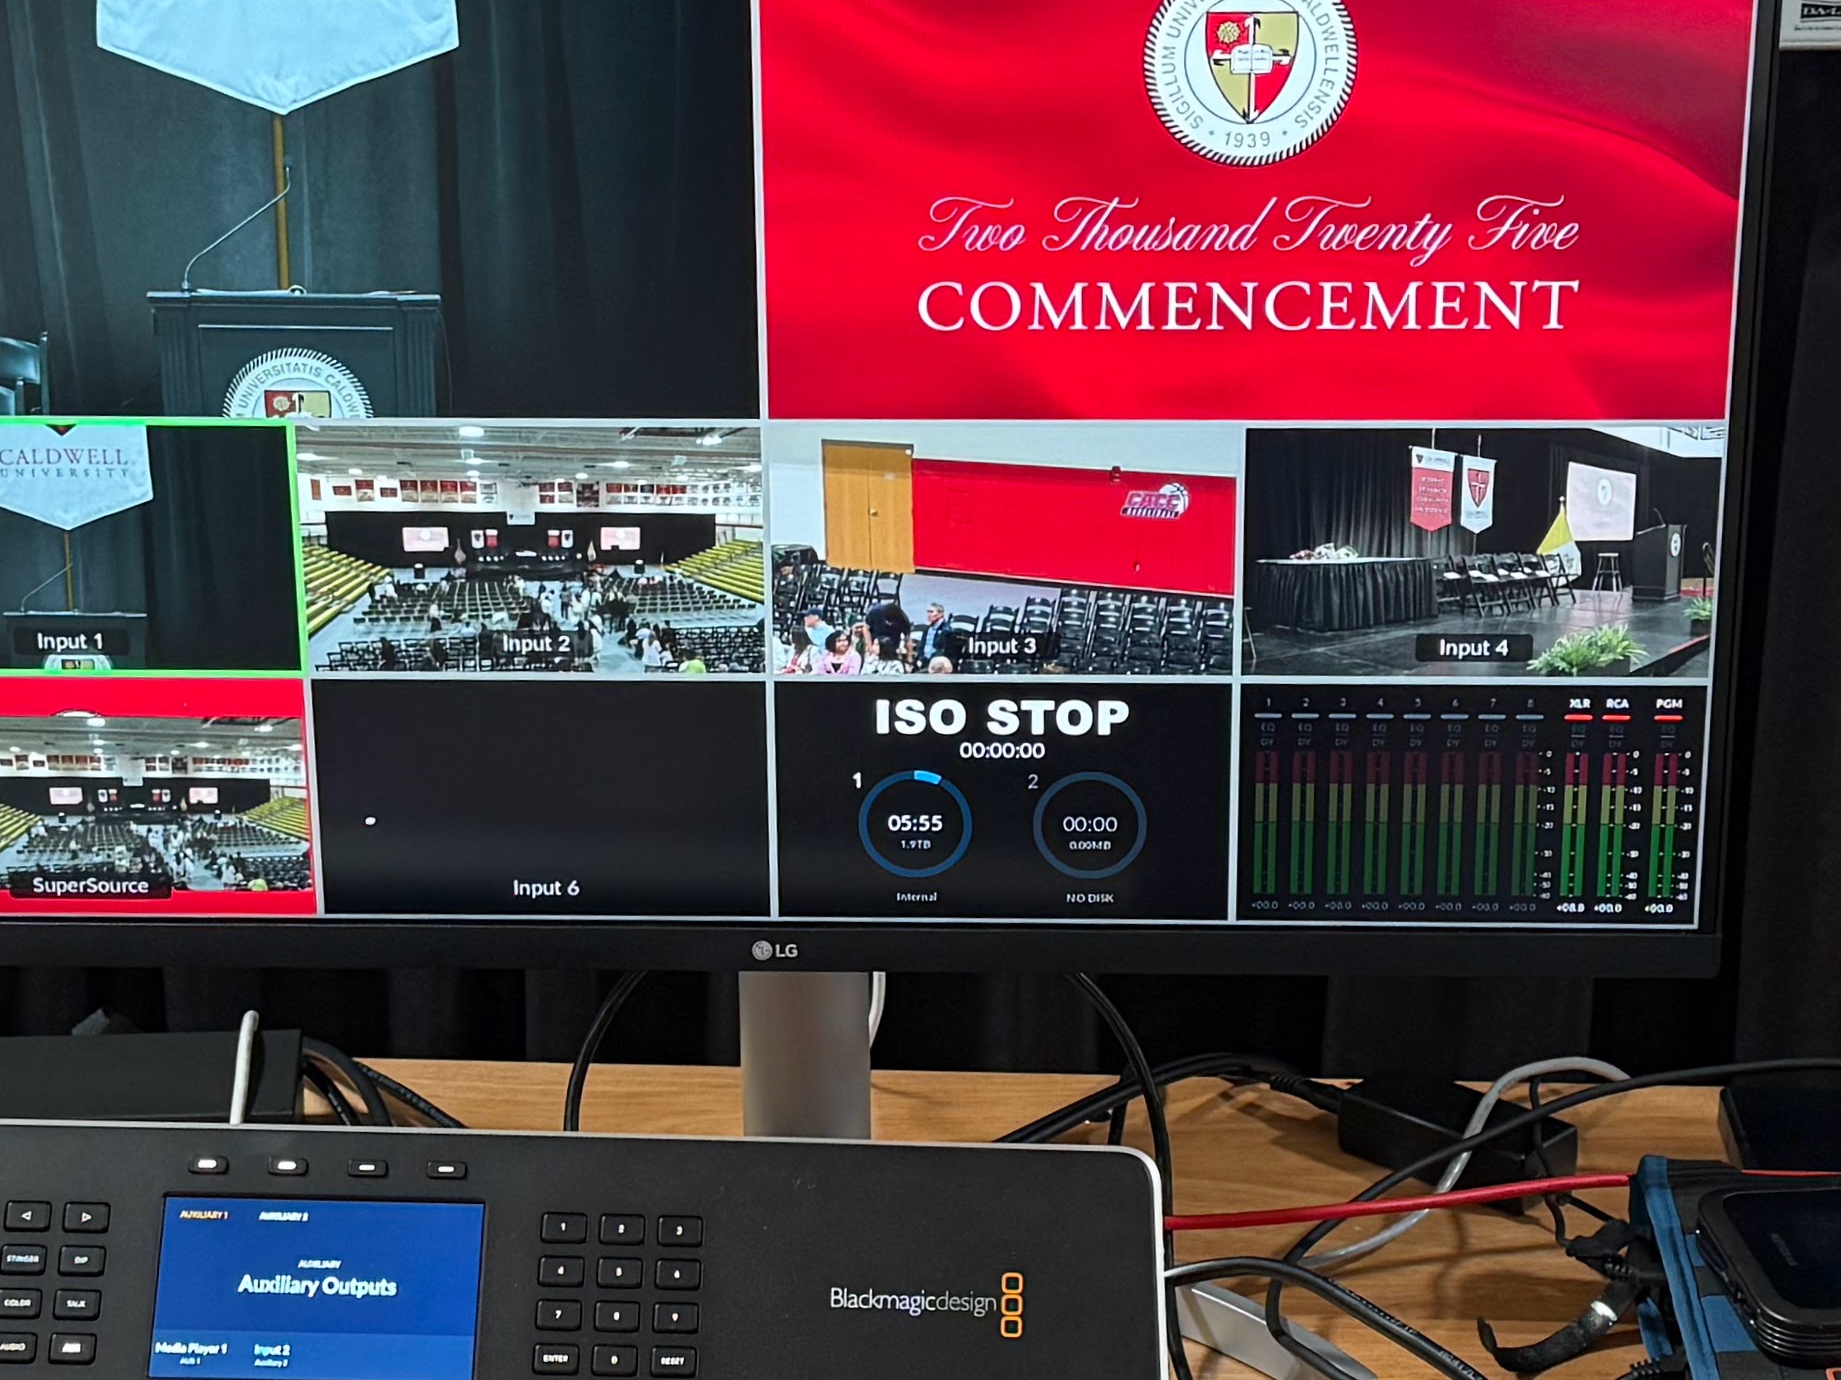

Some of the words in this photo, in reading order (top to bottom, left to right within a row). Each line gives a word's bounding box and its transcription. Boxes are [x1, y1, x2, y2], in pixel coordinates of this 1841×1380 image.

[1161, 46, 1204, 130] SIGILLUM
[1225, 132, 1271, 148] 1939
[916, 194, 1027, 255] Two
[1041, 194, 1279, 255] Thousand
[1271, 194, 1456, 268] Twenty
[1465, 193, 1580, 254] Five
[916, 278, 1580, 333] COMMENCEMENT
[237, 362, 323, 409] UNIVERSITATIS
[0, 467, 130, 478] UNIVERSITY
[38, 632, 87, 652] Input
[94, 633, 104, 650] 1
[503, 635, 554, 656] Input
[558, 636, 571, 652] 2
[968, 637, 1019, 656] Input
[1024, 637, 1037, 654] 3
[1439, 639, 1491, 658] Input
[1495, 640, 1509, 655] 4
[1569, 698, 1590, 709] XLR
[1605, 698, 1630, 709] RCA
[1655, 698, 1683, 709] PGM
[876, 699, 967, 735] ISO
[987, 699, 1130, 736] STOP
[960, 742, 1046, 759] 00:00:00
[853, 772, 862, 789] 1
[1027, 774, 1039, 790] 2
[887, 814, 943, 832] 05:55
[1063, 816, 1118, 833] 00:00
[900, 839, 932, 850] 1.9TB
[33, 877, 149, 897] SuperSource
[513, 879, 562, 898] Input
[566, 879, 580, 897] 6
[896, 891, 938, 903] Internal
[1066, 893, 1085, 904] NO
[1087, 893, 1115, 904] DISK
[775, 943, 798, 959] LG
[237, 1273, 319, 1298] Auxiliary
[322, 1276, 398, 1299] Outputs
[830, 1286, 998, 1318] Blackmagicdesign
